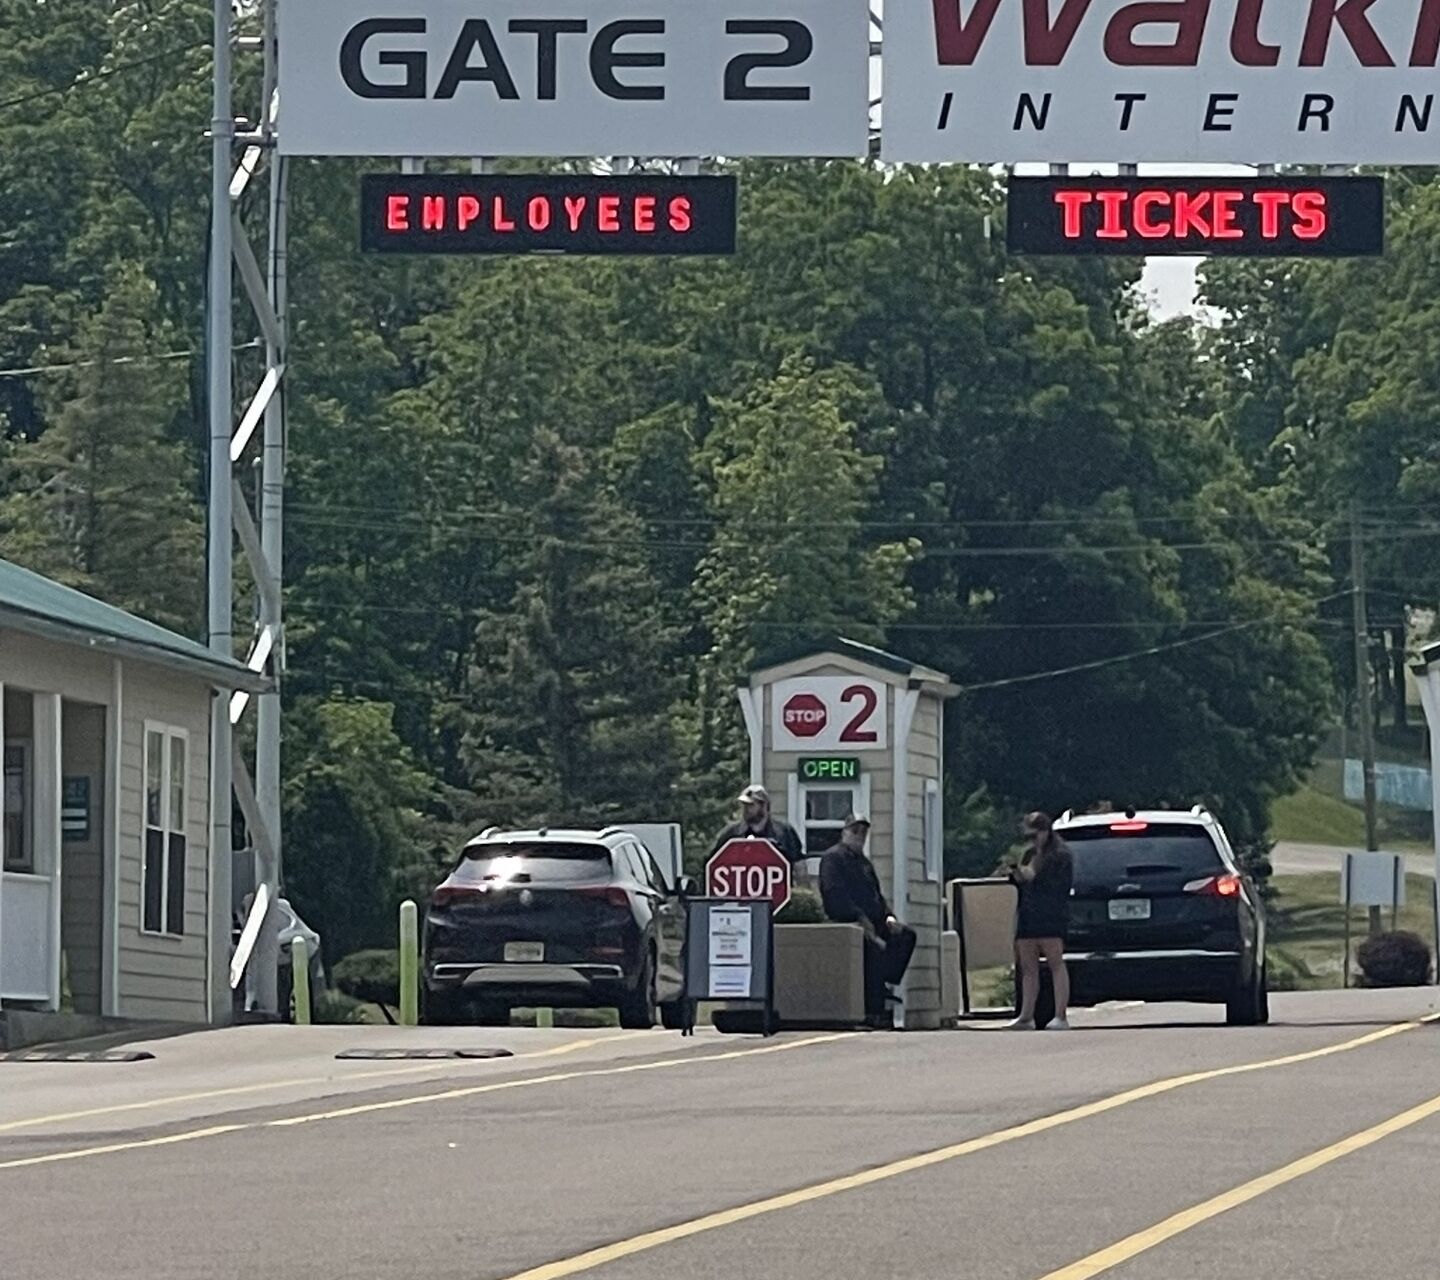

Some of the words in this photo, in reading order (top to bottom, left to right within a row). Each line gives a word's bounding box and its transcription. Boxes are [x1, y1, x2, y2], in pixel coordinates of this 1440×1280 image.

[339, 18, 666, 101] GATE
[723, 19, 814, 101] 2
[387, 196, 692, 231] EMPLOYEES
[1055, 190, 1327, 239] TICKETS
[785, 709, 826, 722] STOP
[838, 684, 878, 742] 2
[803, 761, 855, 777] OPEN
[713, 865, 784, 897] STOP
